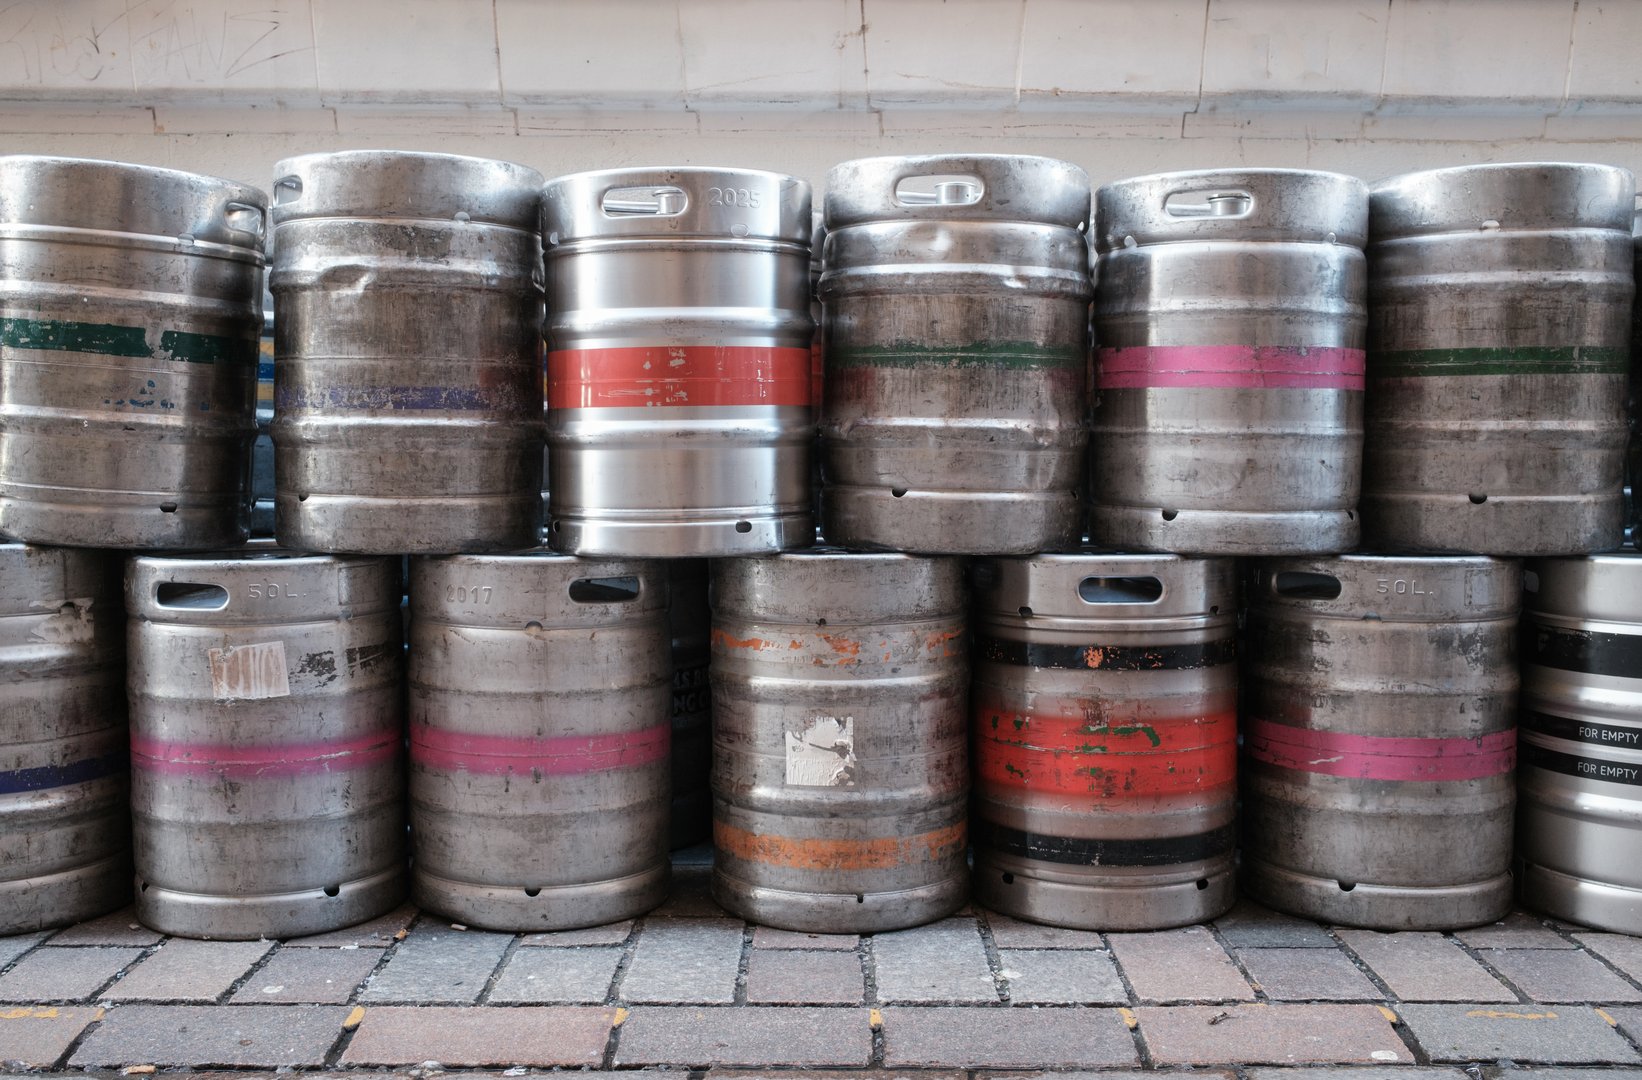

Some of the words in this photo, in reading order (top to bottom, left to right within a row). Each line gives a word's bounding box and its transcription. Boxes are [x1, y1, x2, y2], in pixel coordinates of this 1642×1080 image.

[708, 187, 760, 208] 2025
[447, 584, 492, 604] 2017
[1579, 727, 1598, 739] FOR
[1601, 730, 1639, 743] EMPTY
[1578, 762, 1597, 774] FOR
[1600, 765, 1638, 779] EMPTY
